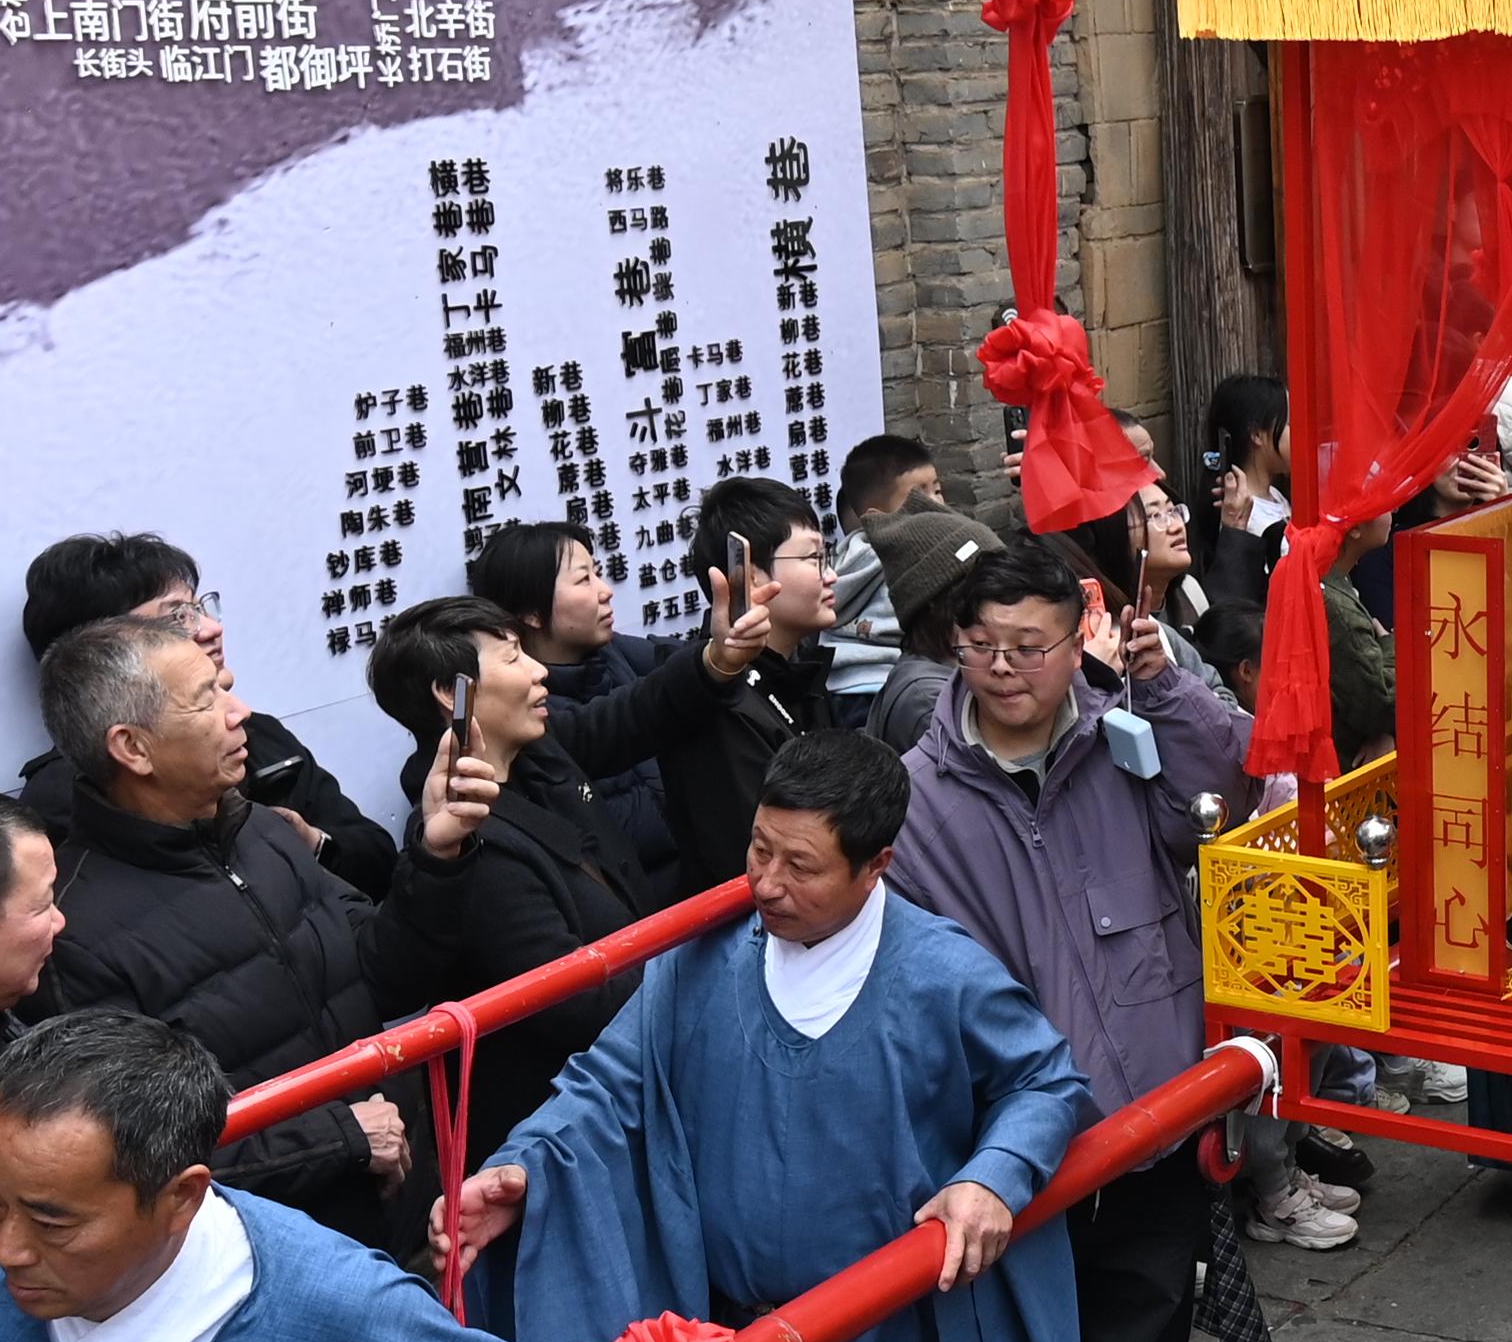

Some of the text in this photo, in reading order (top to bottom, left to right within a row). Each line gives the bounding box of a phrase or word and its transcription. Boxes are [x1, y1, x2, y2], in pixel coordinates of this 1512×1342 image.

[74, 47, 153, 79] 长街头
[159, 44, 254, 83] 临江门
[259, 44, 374, 92] 都御坪
[407, 45, 491, 82] 打石街
[428, 157, 491, 199] 横巷
[605, 165, 666, 193] 将乐巷
[607, 205, 669, 235] 西马路
[773, 278, 819, 311] 新巷
[443, 326, 507, 360] 福州巷
[779, 314, 821, 345] 柳巷
[686, 339, 743, 369] 卡马巷
[781, 347, 823, 380] 花巷
[447, 358, 513, 394] 水洋巷
[532, 360, 583, 397] 新巷
[695, 375, 752, 407] 丁家巷
[354, 384, 429, 421] 炉子巷
[541, 393, 592, 430] 柳巷
[352, 421, 428, 460] 前卫巷
[548, 425, 599, 462] 花巷
[706, 410, 762, 443] 福州巷
[716, 445, 771, 478] 水洋巷
[564, 489, 615, 529] 扇巷
[632, 477, 691, 512] 太平巷
[340, 499, 416, 539] 陶朱巷
[321, 577, 398, 619] 禅师巷
[1430, 591, 1489, 951] 永结同心
